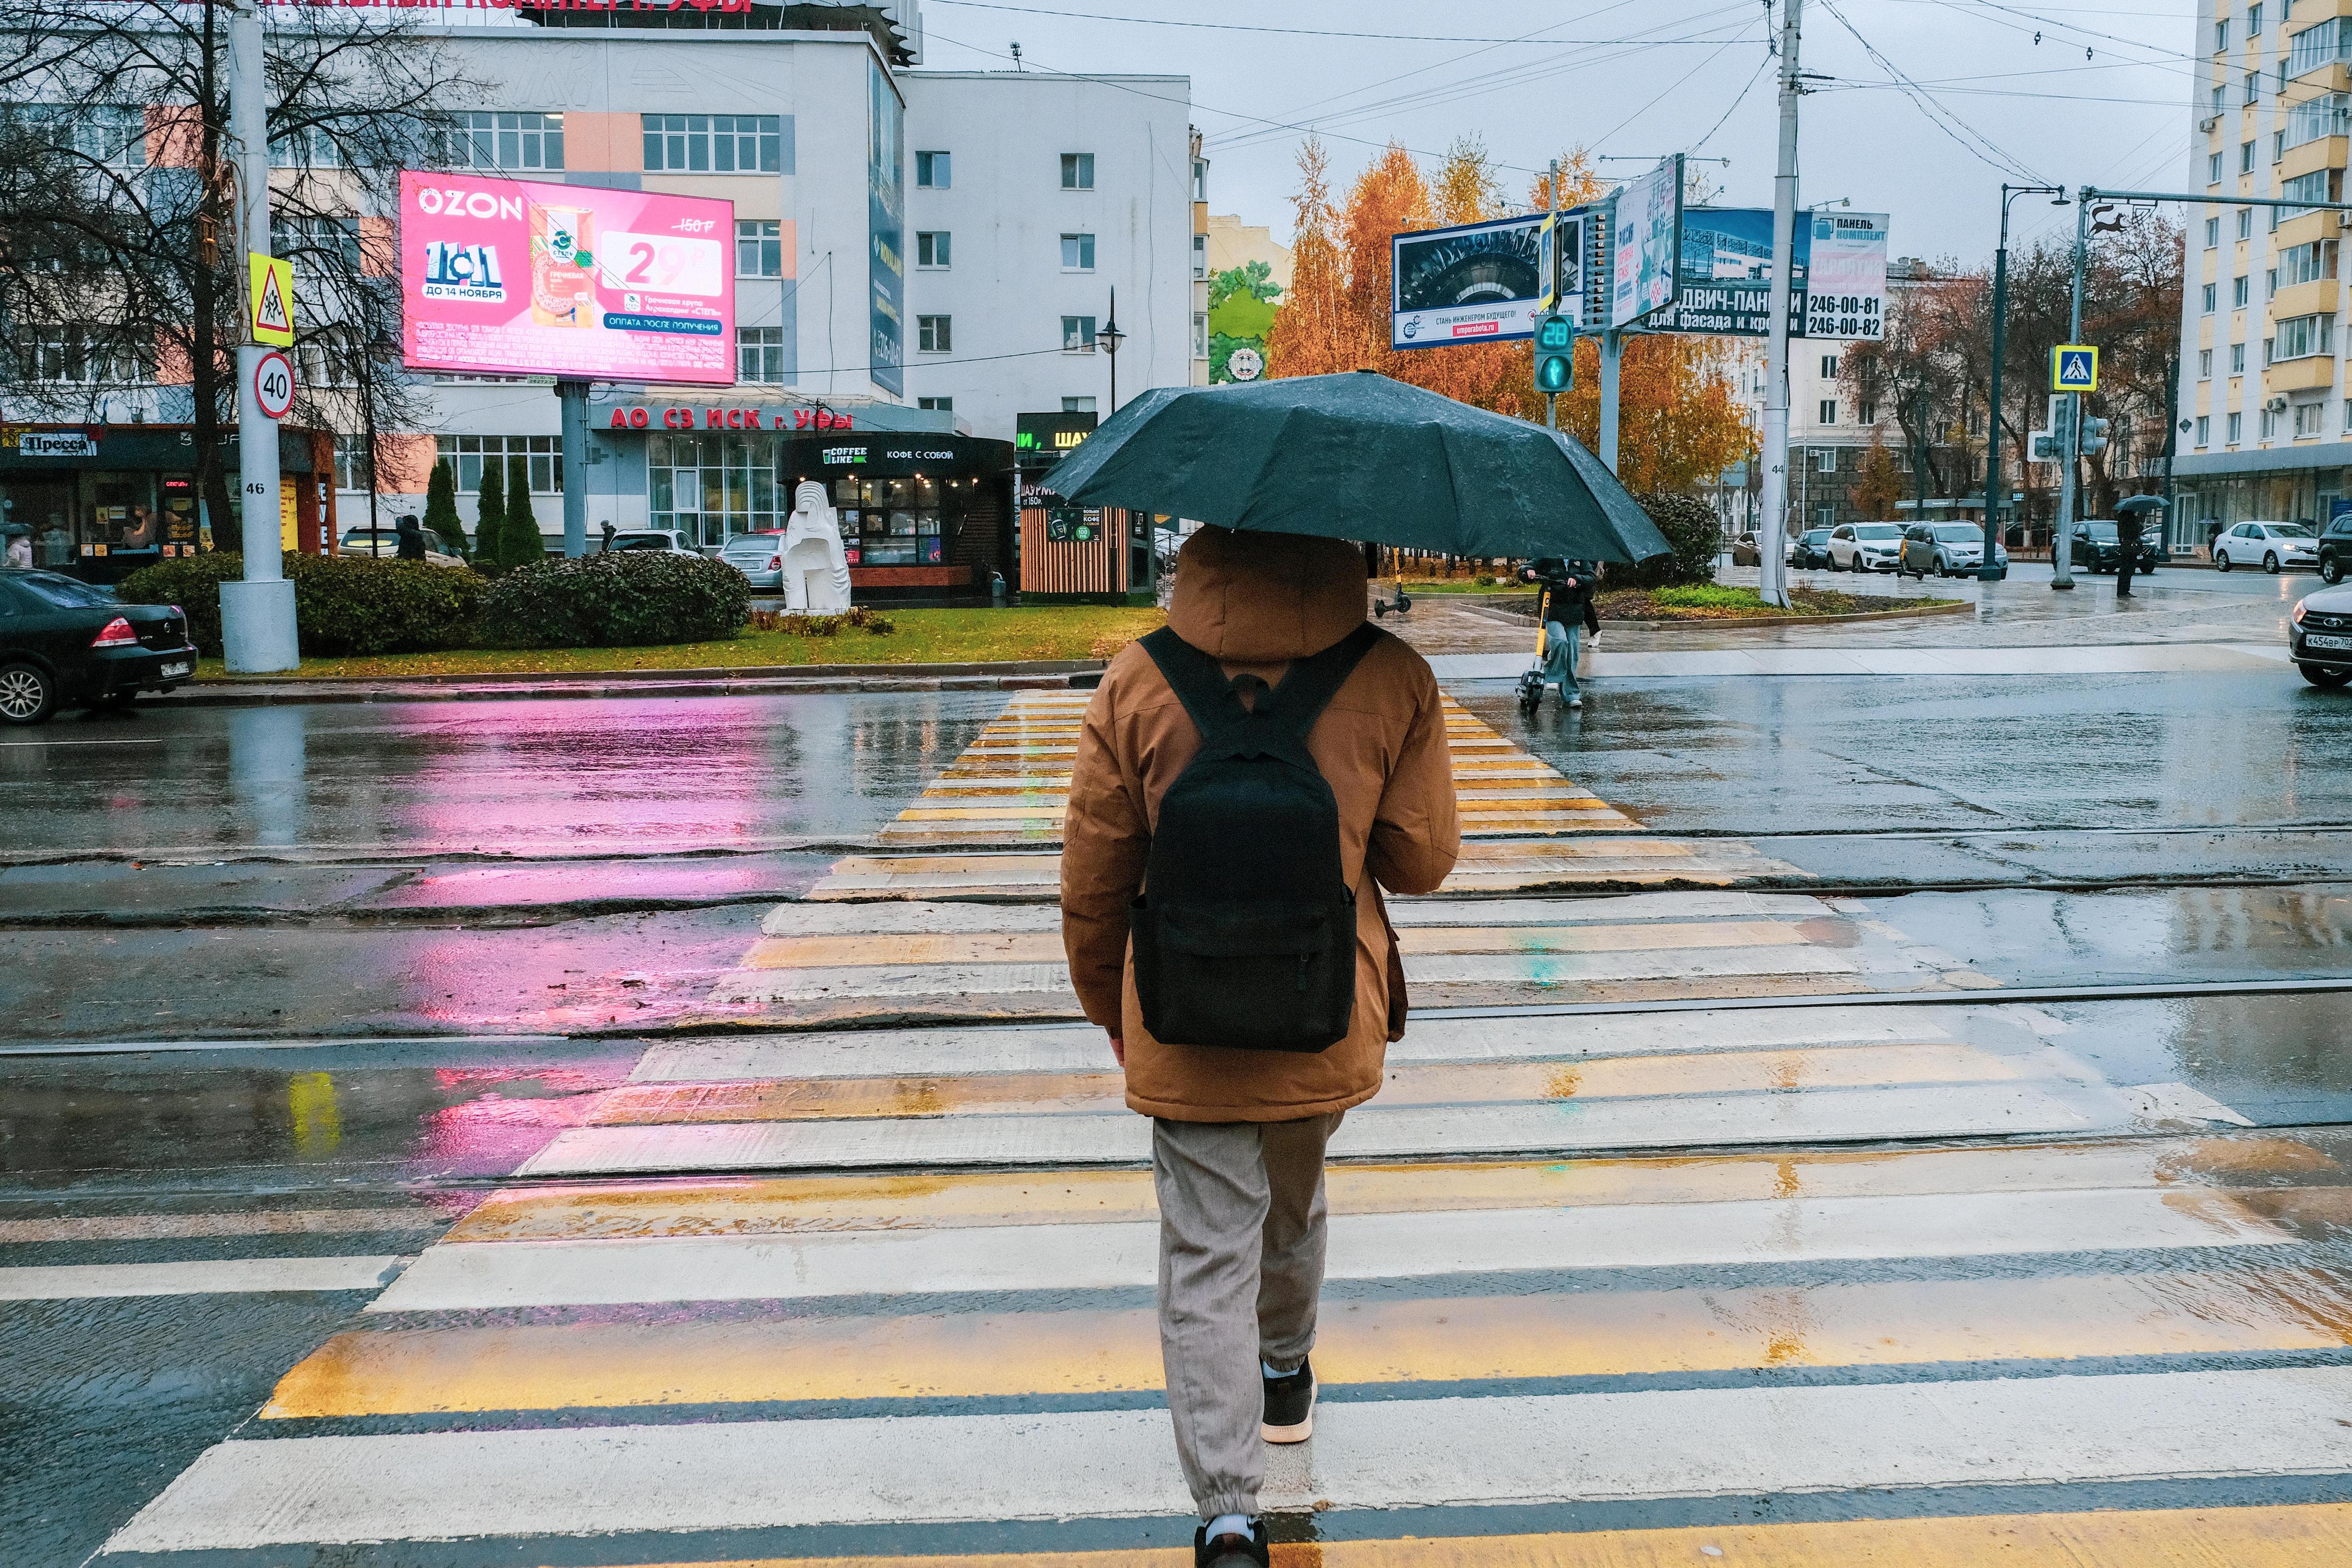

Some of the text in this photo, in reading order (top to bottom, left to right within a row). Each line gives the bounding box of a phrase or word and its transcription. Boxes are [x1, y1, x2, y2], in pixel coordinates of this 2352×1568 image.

[419, 188, 522, 221] OZON
[1837, 219, 1873, 229] ПАНЕЛЬ
[1836, 230, 1886, 240] КОМПЛЕКТ
[625, 242, 685, 286] 29
[426, 286, 442, 295] ДО
[460, 289, 502, 299] НОЯБРЯ
[644, 295, 680, 305] Гречневая
[1810, 295, 1879, 314] 246-00-81
[1453, 314, 1485, 323] ИНЖЕНЕРОМ
[1486, 310, 1516, 320] БУДУЩЕГО!
[1649, 313, 1674, 327] для
[1680, 311, 1731, 330] фасада
[1737, 317, 1744, 329] и
[609, 318, 718, 331] ОПЛАТА ПОСЛЕ ПОЛУЧЕНИЯ
[1456, 324, 1494, 335] umporabota.ru
[1809, 317, 1880, 335] 246-00-82
[1544, 322, 1567, 346] 28
[263, 372, 286, 399] 40
[611, 407, 853, 430] АО СЗ ИСК г. Уфы
[25, 437, 87, 453] Пресса
[831, 447, 867, 456] COFFEE
[923, 451, 954, 459] СОБОЙ
[1772, 465, 1783, 474] 44
[246, 483, 264, 494] 46
[2308, 637, 2338, 647] К454ВР
